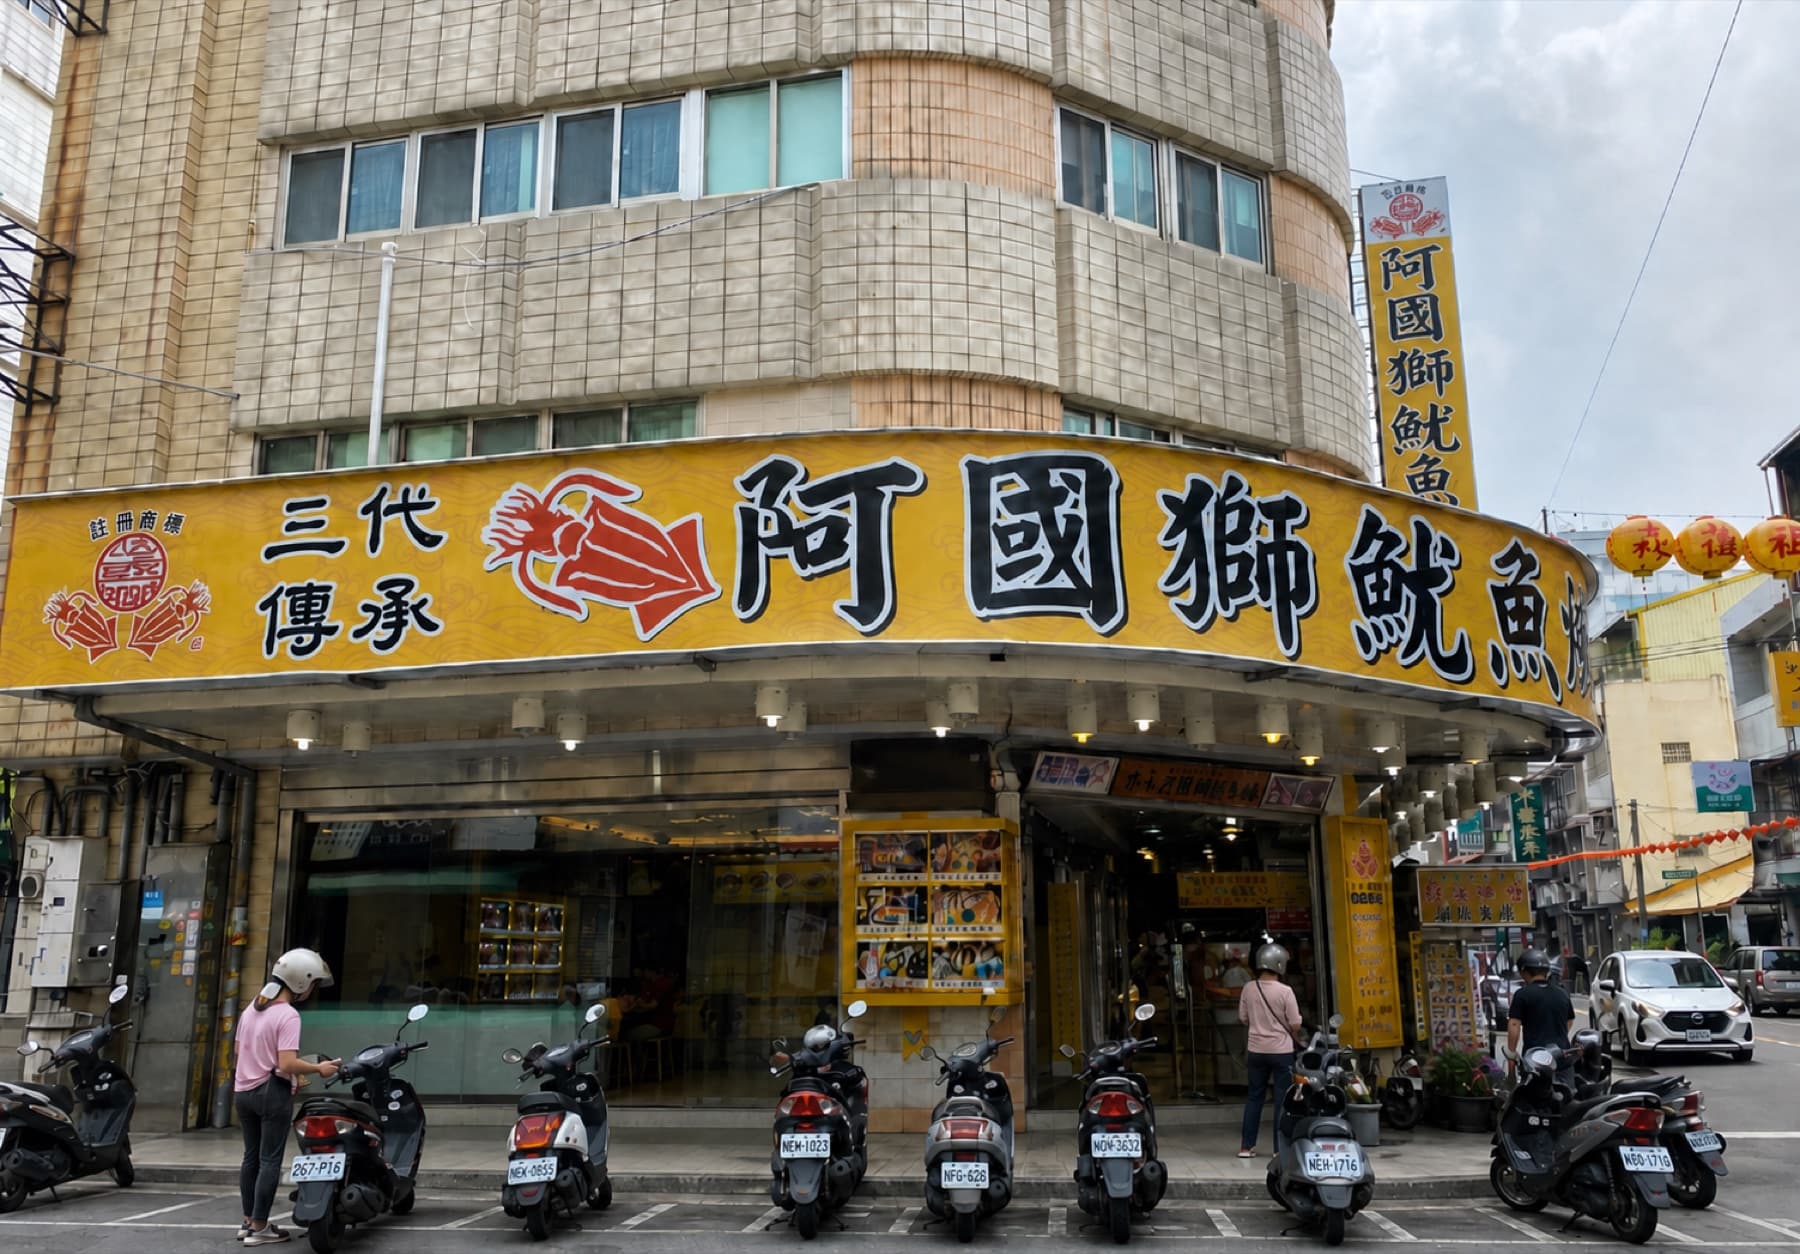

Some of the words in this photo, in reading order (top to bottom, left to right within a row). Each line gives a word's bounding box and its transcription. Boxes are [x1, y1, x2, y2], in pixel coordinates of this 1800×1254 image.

[1380, 244, 1461, 505] 阿國獅魷魚
[89, 509, 185, 540] 註冊商標
[262, 485, 447, 562] 三代
[257, 575, 441, 657] 傳承
[291, 1161, 342, 1177] 267-P16
